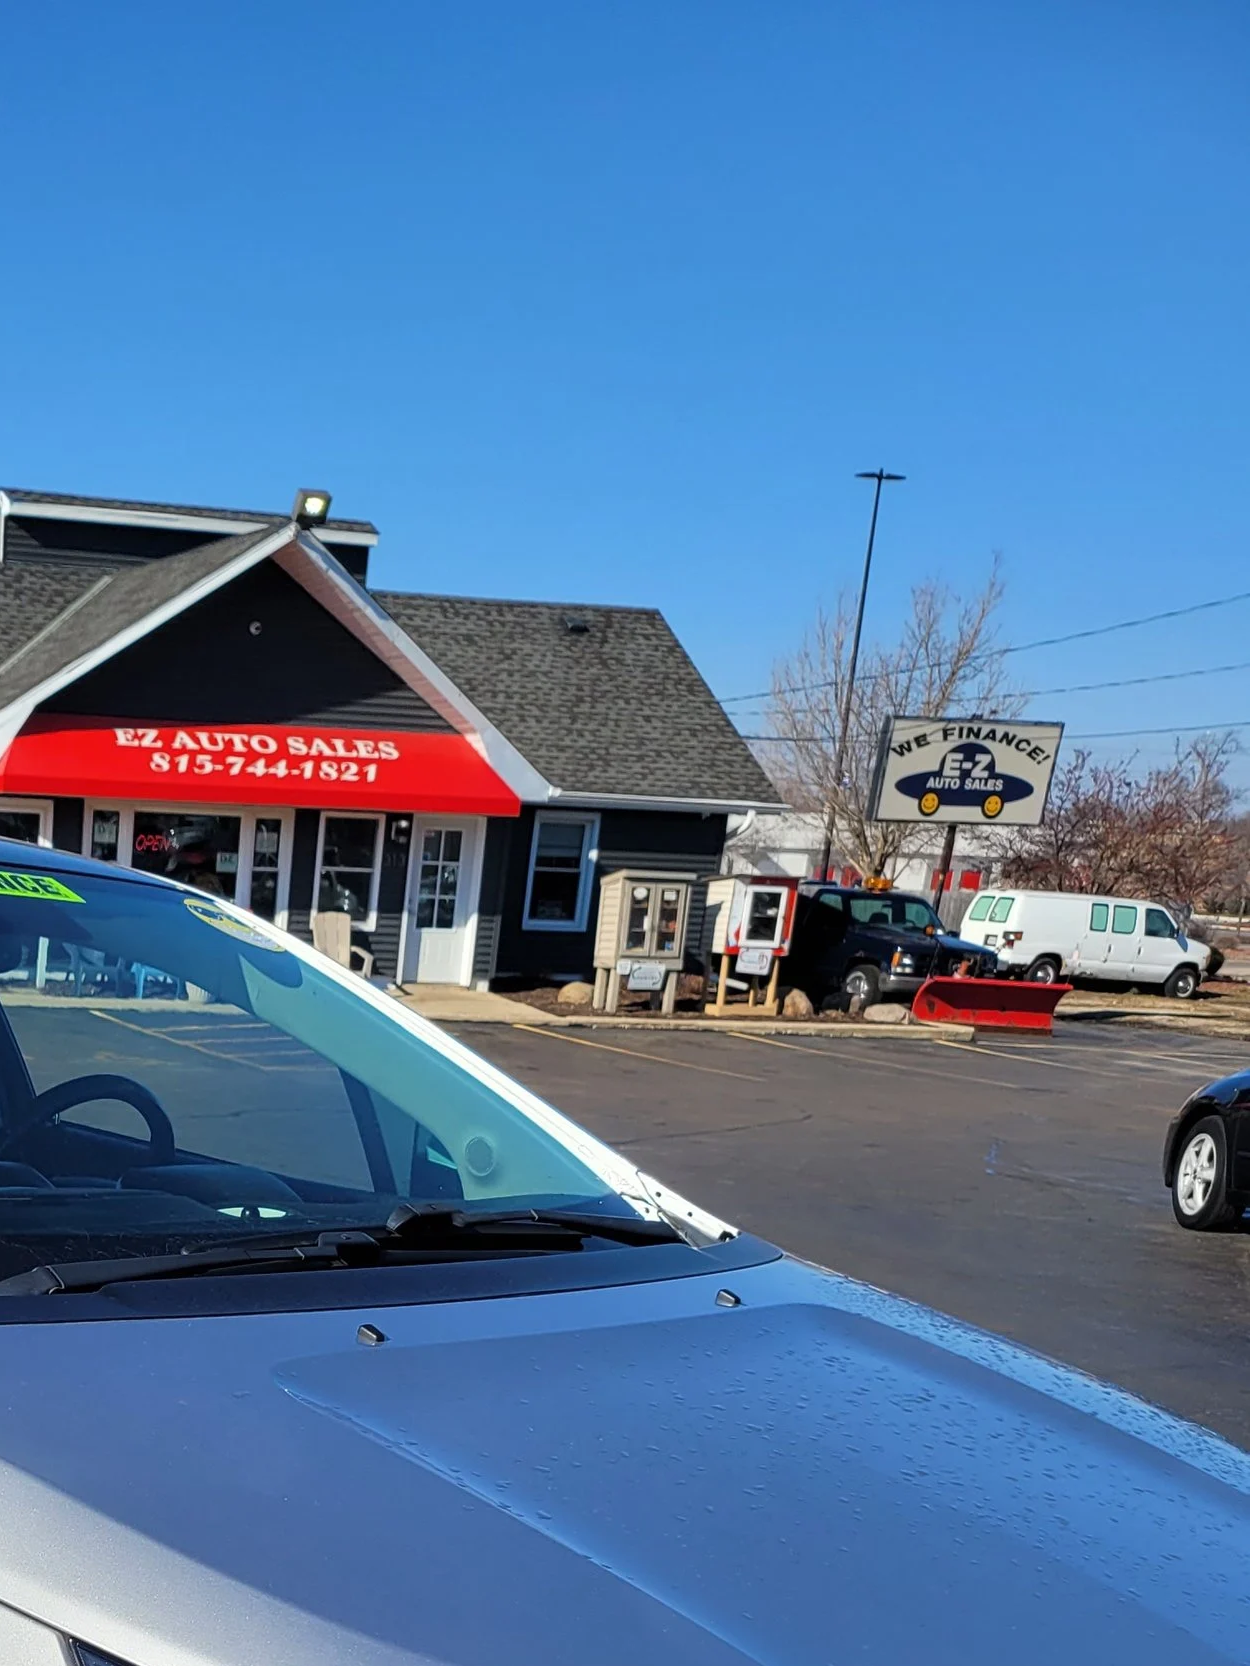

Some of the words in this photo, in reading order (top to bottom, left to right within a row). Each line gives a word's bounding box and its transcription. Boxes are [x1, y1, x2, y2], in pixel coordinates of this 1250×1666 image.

[113, 728, 163, 748] EZ
[171, 730, 278, 754] AUTO
[287, 736, 400, 760] SALES
[891, 734, 930, 758] WE
[942, 726, 1051, 765] FINANCE!
[150, 752, 378, 783] 815-744-1821
[942, 752, 993, 778] E-Z
[926, 776, 960, 789] AUTO
[964, 778, 1003, 791] SALES
[136, 834, 172, 852] OPEN
